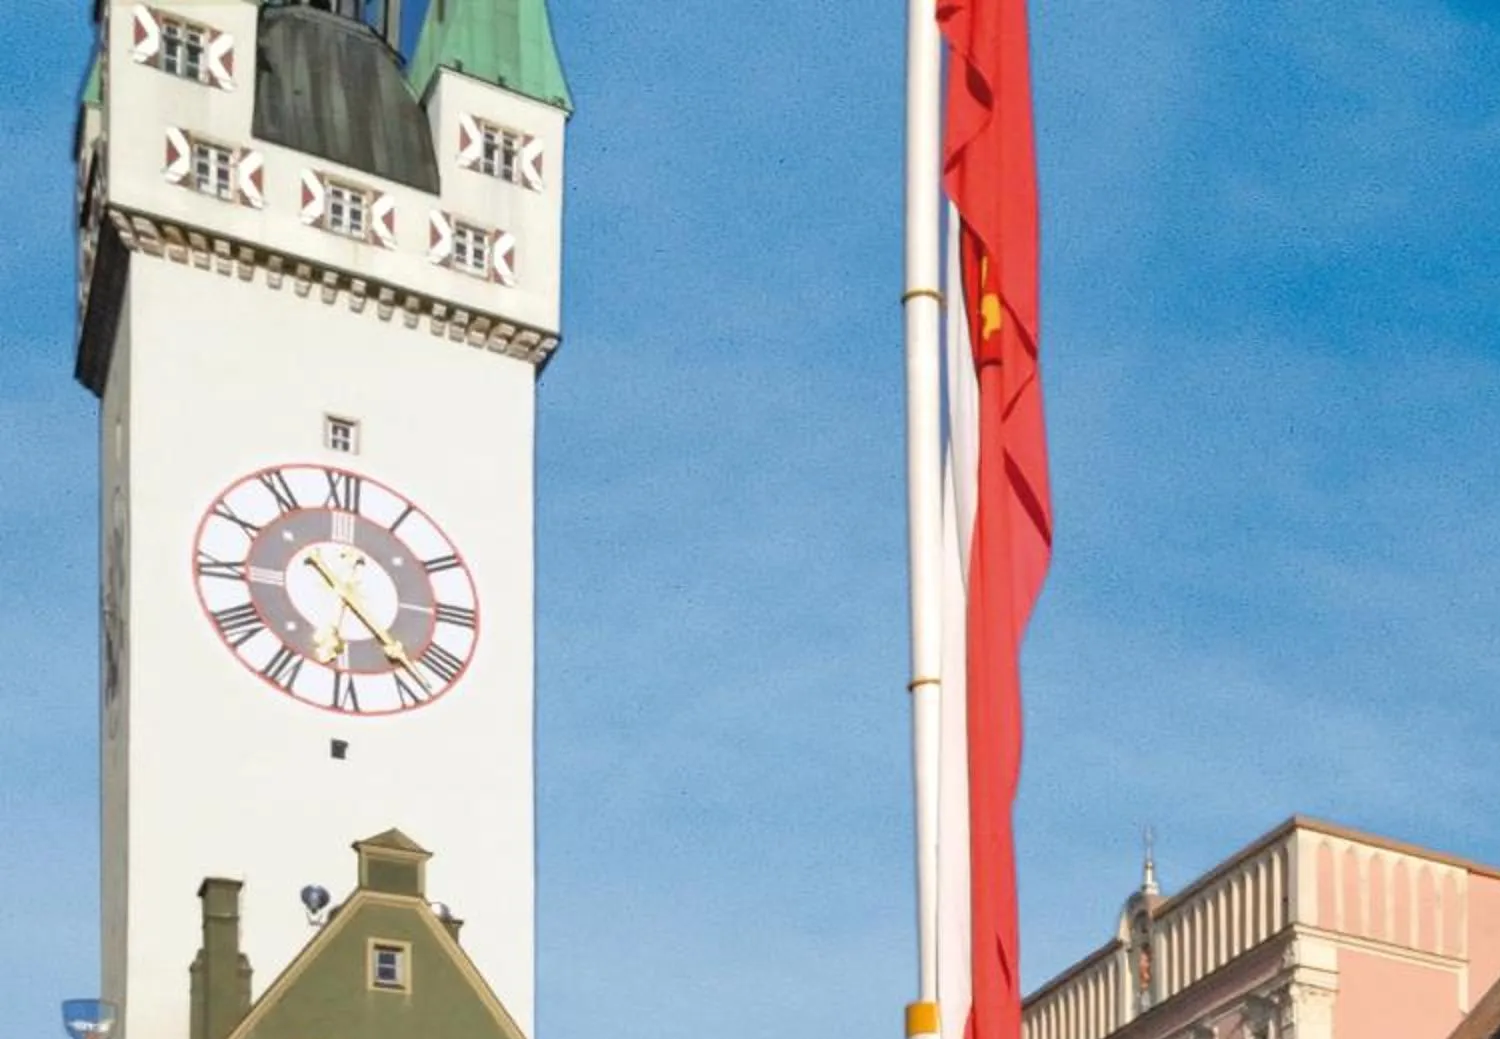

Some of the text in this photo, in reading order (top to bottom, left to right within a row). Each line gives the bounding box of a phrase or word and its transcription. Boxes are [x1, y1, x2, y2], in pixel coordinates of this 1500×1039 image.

[259, 469, 300, 512] XI
[325, 469, 360, 515] XII
[212, 501, 260, 541] X
[198, 551, 247, 580] IX
[423, 554, 463, 574] II
[212, 603, 264, 648] VIII
[436, 603, 477, 628] III
[263, 647, 304, 692] VII
[331, 671, 361, 712] VI
